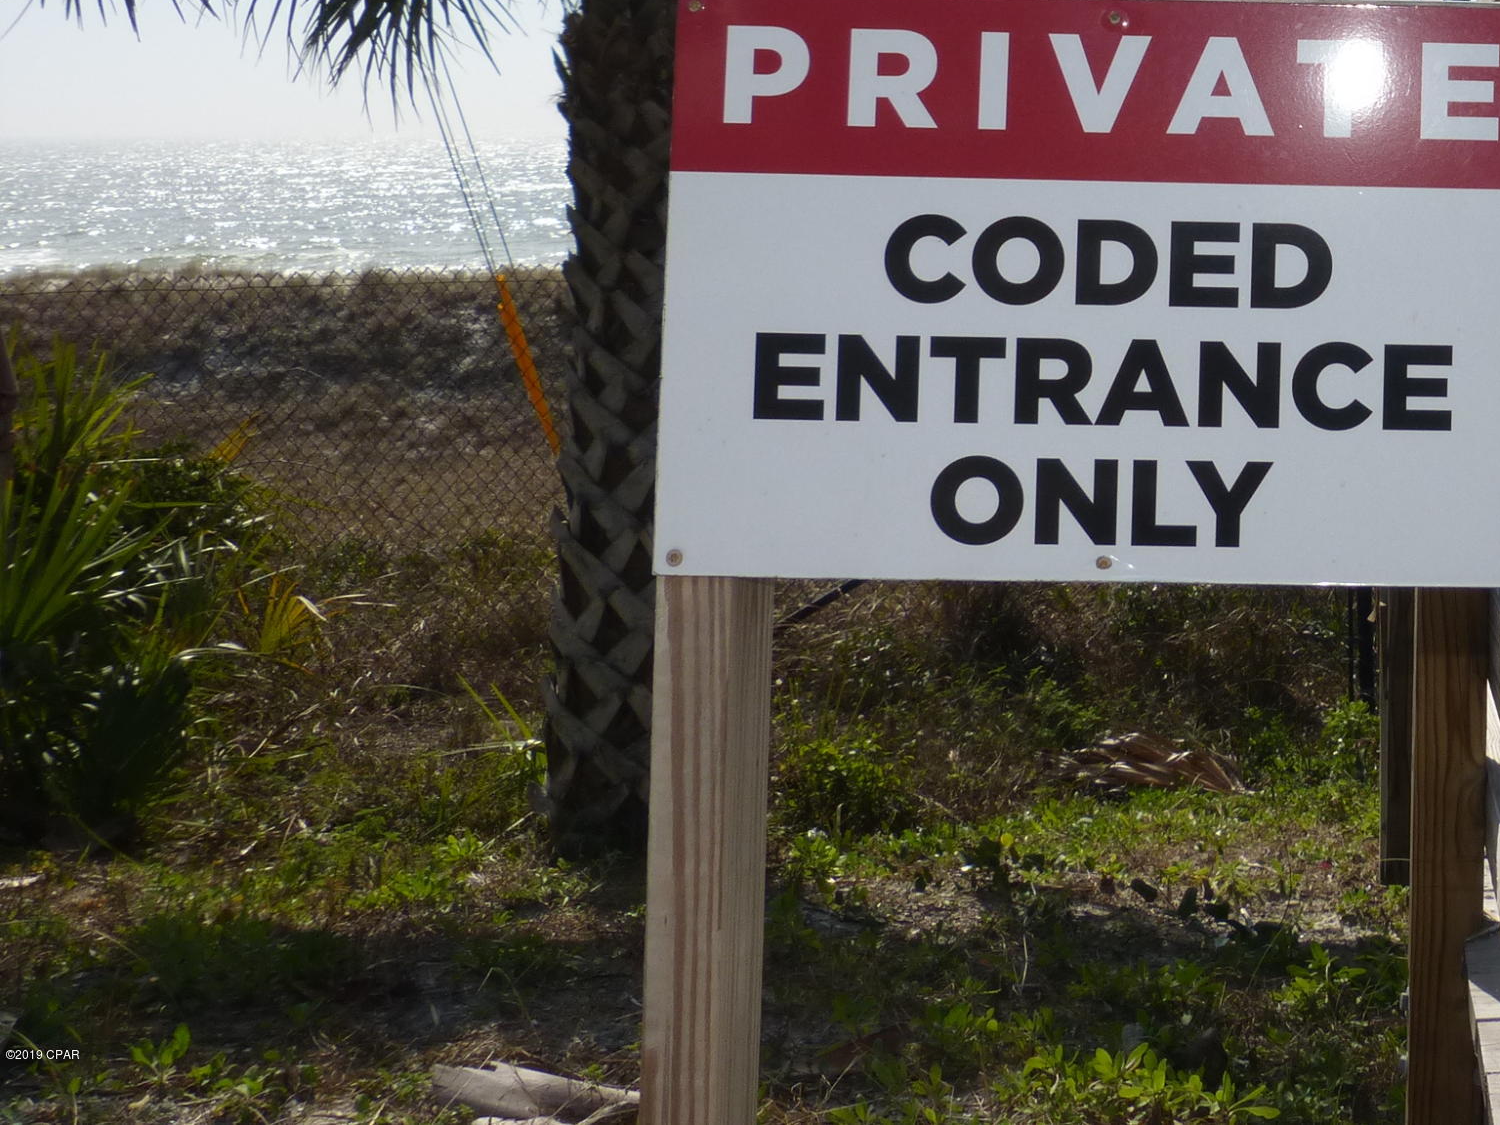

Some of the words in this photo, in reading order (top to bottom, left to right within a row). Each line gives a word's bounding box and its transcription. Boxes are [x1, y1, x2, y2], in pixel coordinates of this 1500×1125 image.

[722, 24, 1500, 142] PRIVATE
[884, 213, 1333, 310] CODED
[752, 331, 1454, 432] ENTRANCE
[929, 454, 1274, 549] ONLY
